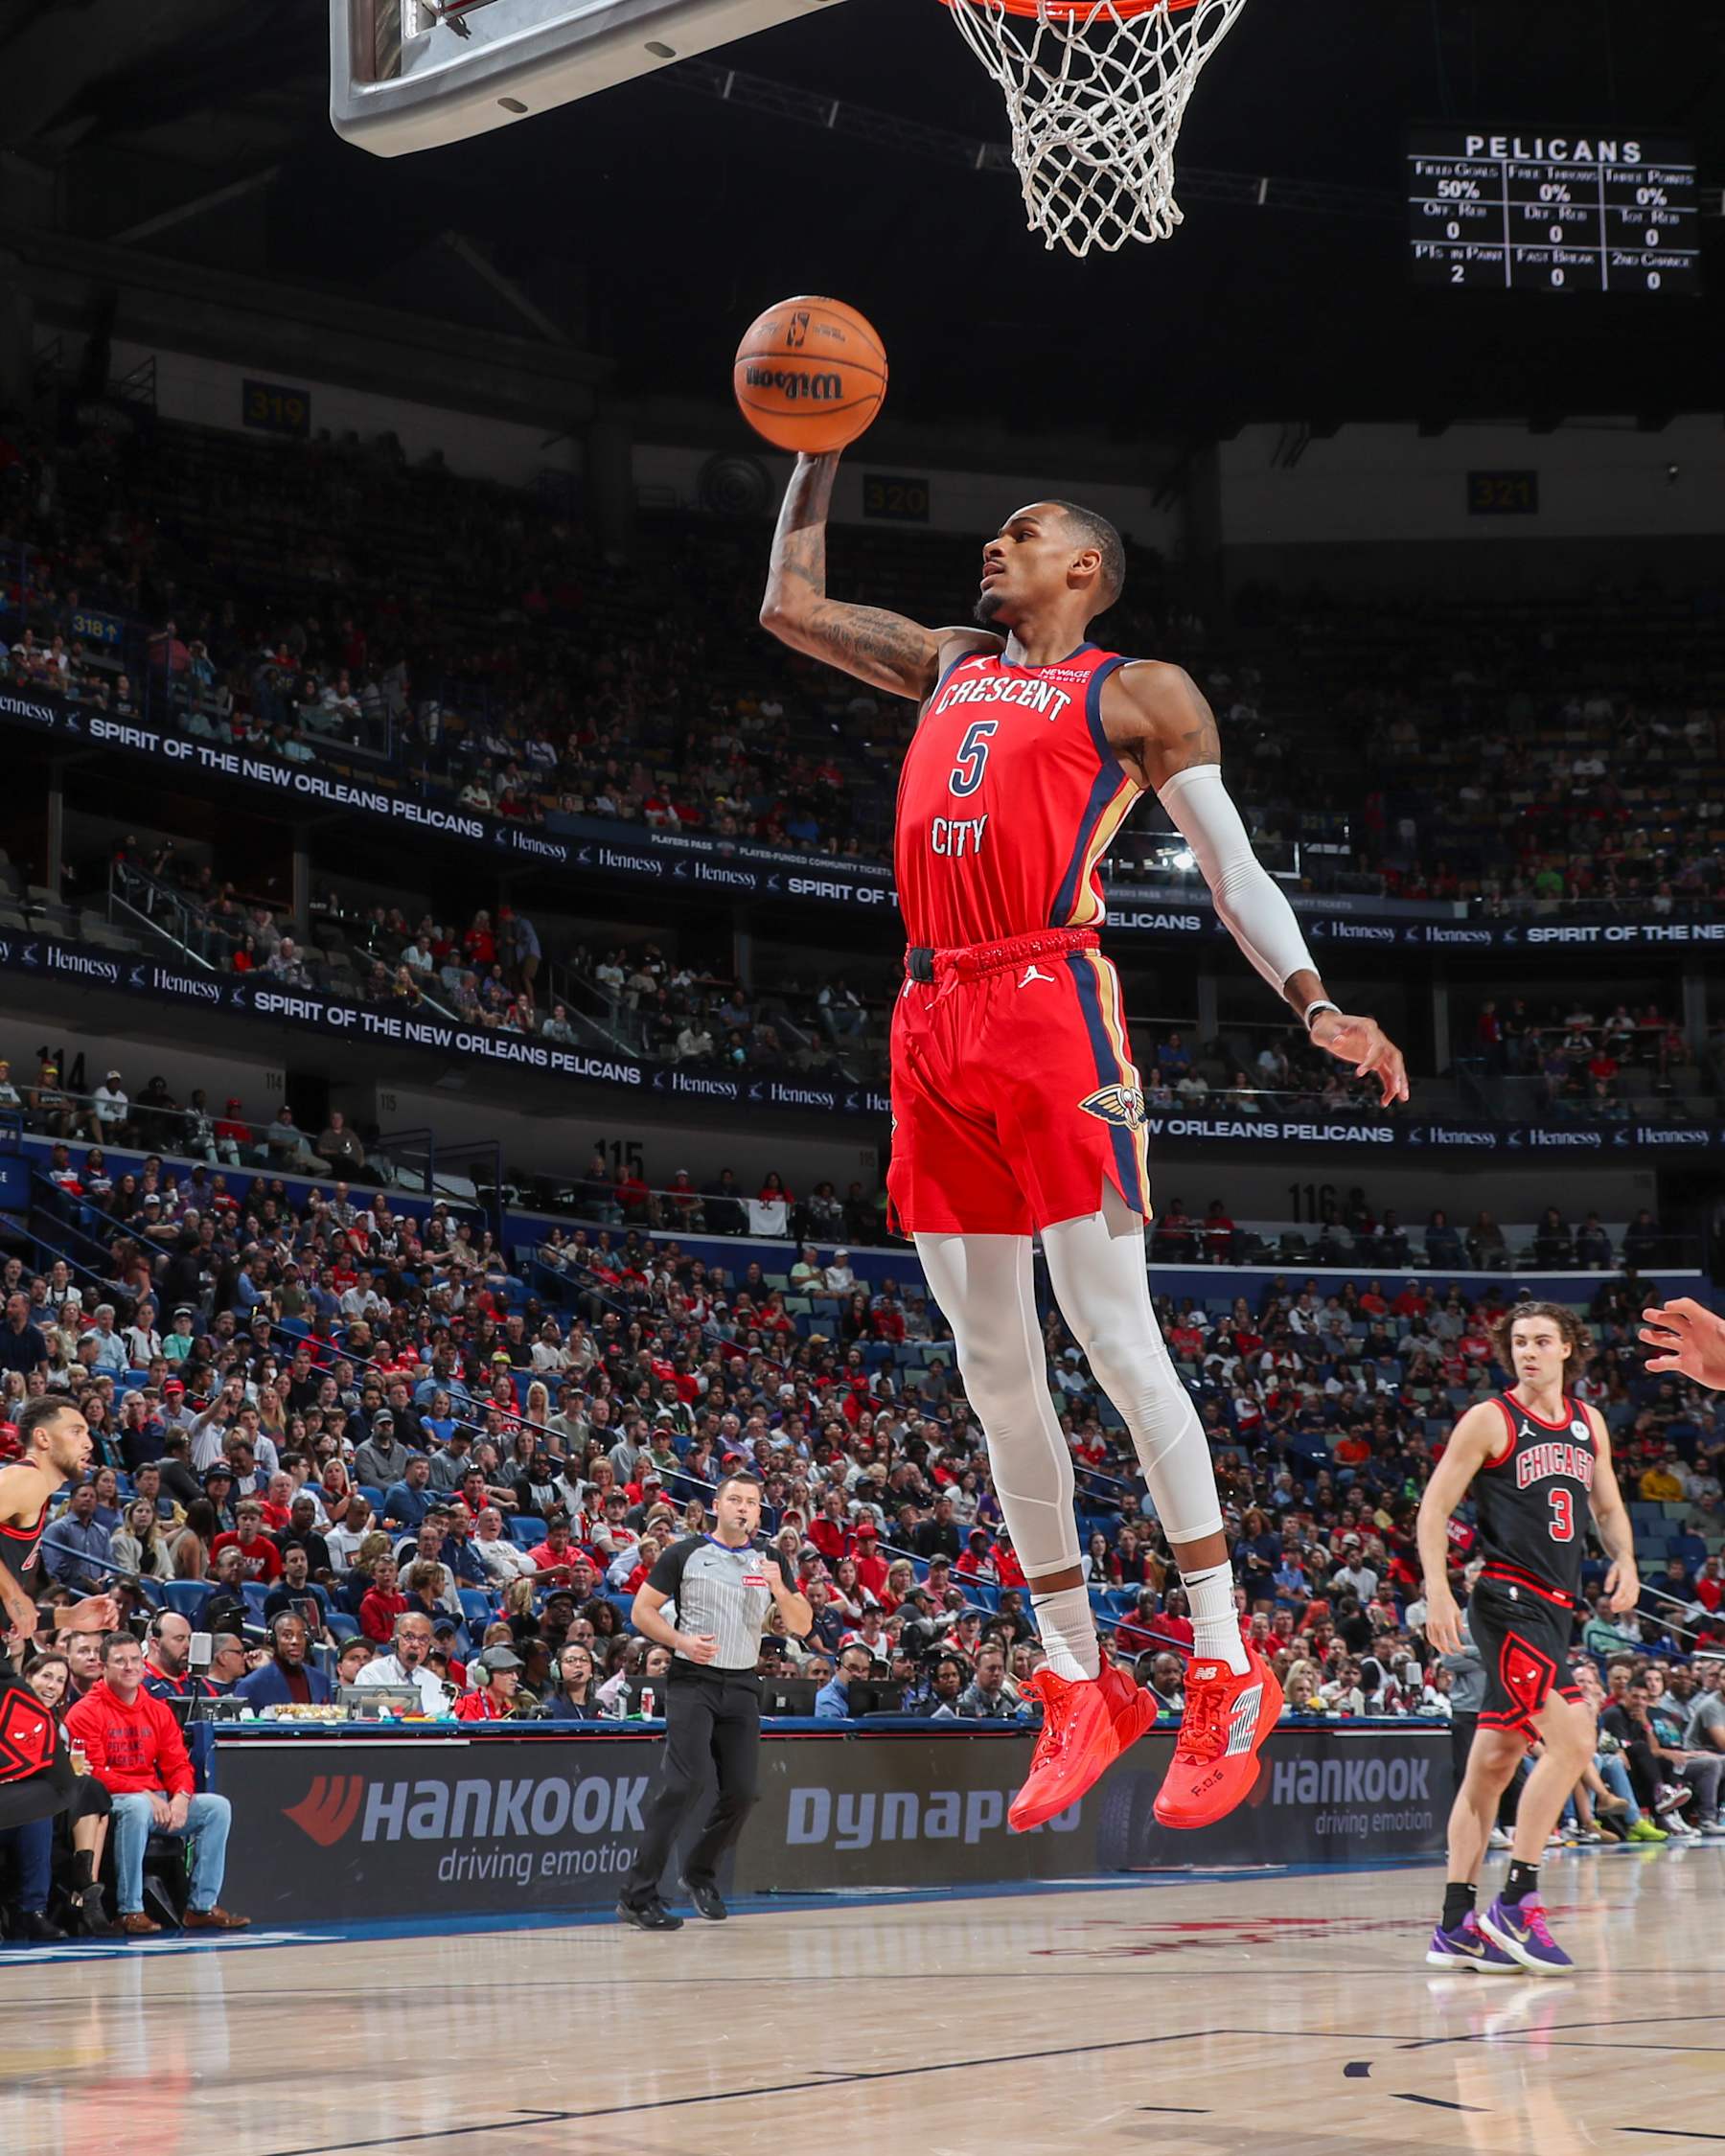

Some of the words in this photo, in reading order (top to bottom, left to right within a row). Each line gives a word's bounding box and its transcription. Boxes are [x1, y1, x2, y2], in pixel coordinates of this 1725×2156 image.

[1465, 135, 1642, 163] PELICANS
[1437, 179, 1481, 199] 50%
[1539, 183, 1571, 202] 0%
[1635, 187, 1668, 206] 0%
[1445, 220, 1460, 240] 0
[1549, 224, 1563, 243] 0
[1644, 228, 1659, 246] 0
[1450, 264, 1465, 283] 2
[1551, 267, 1565, 287] 0
[1646, 271, 1662, 289] 0
[747, 366, 843, 399] Wilson
[249, 389, 307, 428] 319
[866, 481, 928, 514] 320
[1476, 478, 1530, 506] 321
[73, 615, 104, 637] 318
[1040, 668, 1091, 677] NEWAGE
[0, 695, 54, 727] ennessy
[935, 676, 1072, 722] CRESCENT
[948, 721, 999, 797] 5
[89, 718, 160, 752] SPIRIT
[163, 739, 194, 761] OF
[196, 746, 240, 774] THE
[242, 758, 291, 787] NEW
[294, 773, 389, 814] ORLEANS
[392, 799, 484, 838] PELICANS
[513, 830, 567, 862] Hennessy
[652, 834, 689, 848] PLAYERS
[690, 839, 713, 851] PASS
[932, 814, 989, 857] CITY
[599, 847, 663, 877] Hennessy
[739, 846, 807, 865] PLAYER-FUNDED
[808, 856, 858, 873] COMMUNITY
[694, 861, 757, 889] Hennessy
[788, 877, 853, 900] SPIRIT
[856, 886, 886, 905] OF
[1105, 911, 1202, 930] ELICANS
[1331, 921, 1396, 943] Hennessy
[1527, 927, 1601, 943] SPIRIT
[1604, 926, 1639, 942] OF
[1641, 925, 1690, 941] THE
[1692, 924, 1725, 940] NE
[1425, 926, 1492, 946] Hennessy
[47, 946, 121, 983] Hennessy
[153, 967, 222, 1004] Hennessy
[254, 991, 323, 1021] SPIRIT
[326, 1007, 357, 1027] OF
[360, 1012, 402, 1038] THE
[404, 1021, 452, 1047] NEW
[455, 1032, 547, 1067] ORLEANS
[551, 1052, 641, 1086] PELICANS
[265, 1072, 283, 1090] 114
[672, 1072, 738, 1100] Hennessy
[380, 1092, 398, 1112] 115
[770, 1083, 836, 1110] Hennessy
[1167, 1119, 1279, 1139] ORLEANS
[1282, 1123, 1394, 1143] PELICANS
[1430, 1126, 1497, 1149] Hennessy
[1530, 1128, 1602, 1149] Hennessy
[1637, 1126, 1710, 1147] Hennessy
[1289, 1184, 1336, 1223] 116
[1516, 1442, 1595, 1491] CHICAGO
[1548, 1487, 1575, 1543] 3
[1193, 1666, 1218, 1680] NB
[1316, 1809, 1368, 1839] driving
[1372, 1807, 1433, 1832] emotion
[437, 1845, 533, 1885] driving
